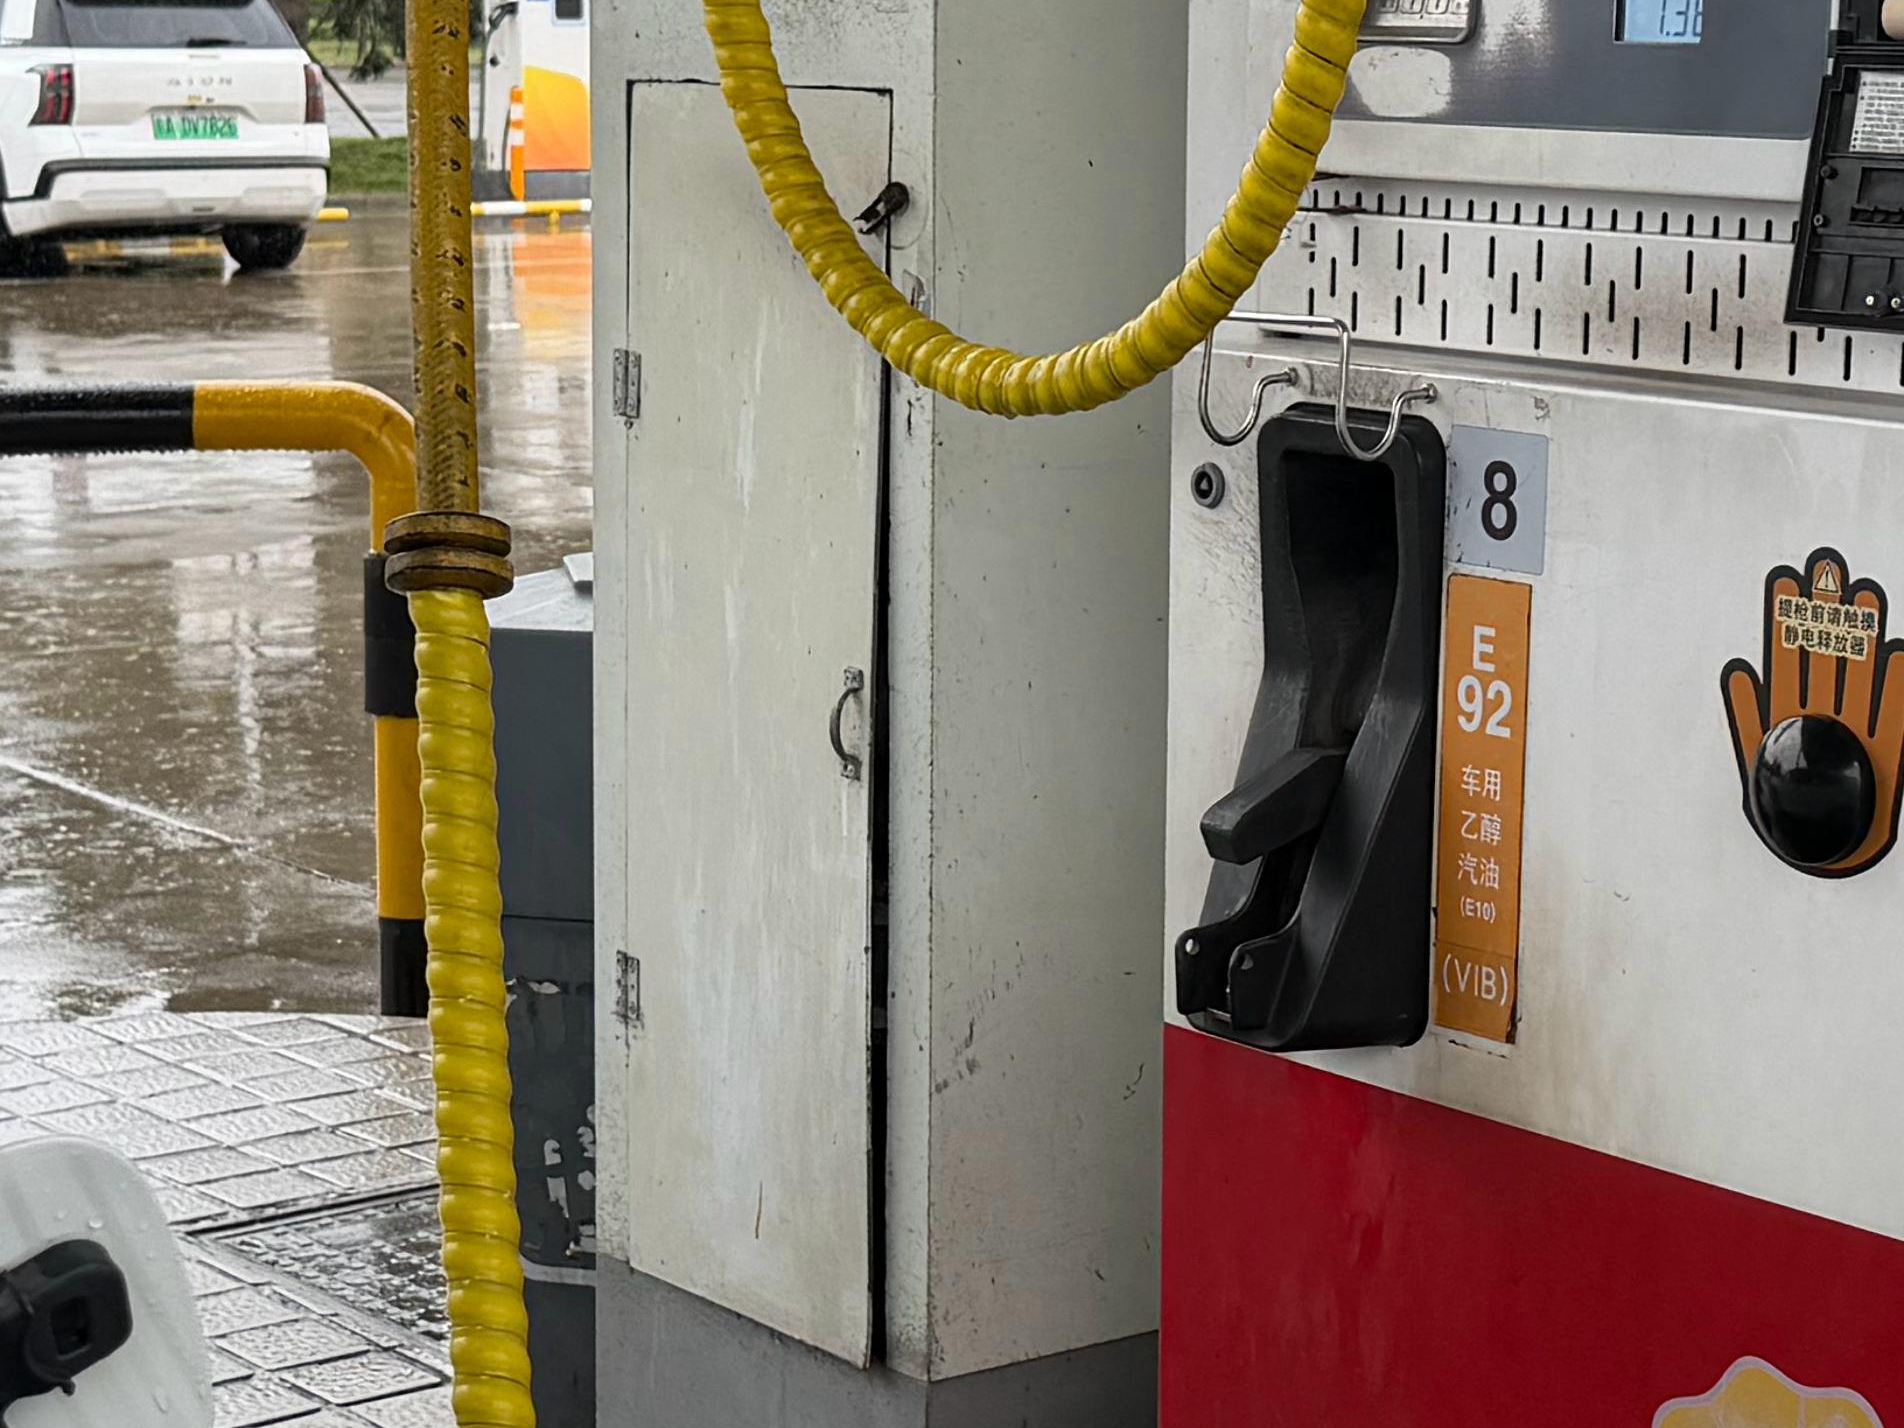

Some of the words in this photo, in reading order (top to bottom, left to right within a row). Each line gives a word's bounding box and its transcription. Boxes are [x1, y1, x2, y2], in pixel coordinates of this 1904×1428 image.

[1481, 460, 1517, 541] 8
[1779, 597, 1877, 633] 提枪前请触摸
[1472, 625, 1496, 672] E
[1784, 625, 1865, 657] 静电释放器
[1457, 675, 1512, 738] 92
[1461, 764, 1501, 801] 车用
[1460, 810, 1501, 845] 乙醇
[1457, 853, 1499, 889] 汽油
[1460, 896, 1496, 923] (E10)
[1442, 953, 1508, 1006] (VIB)
